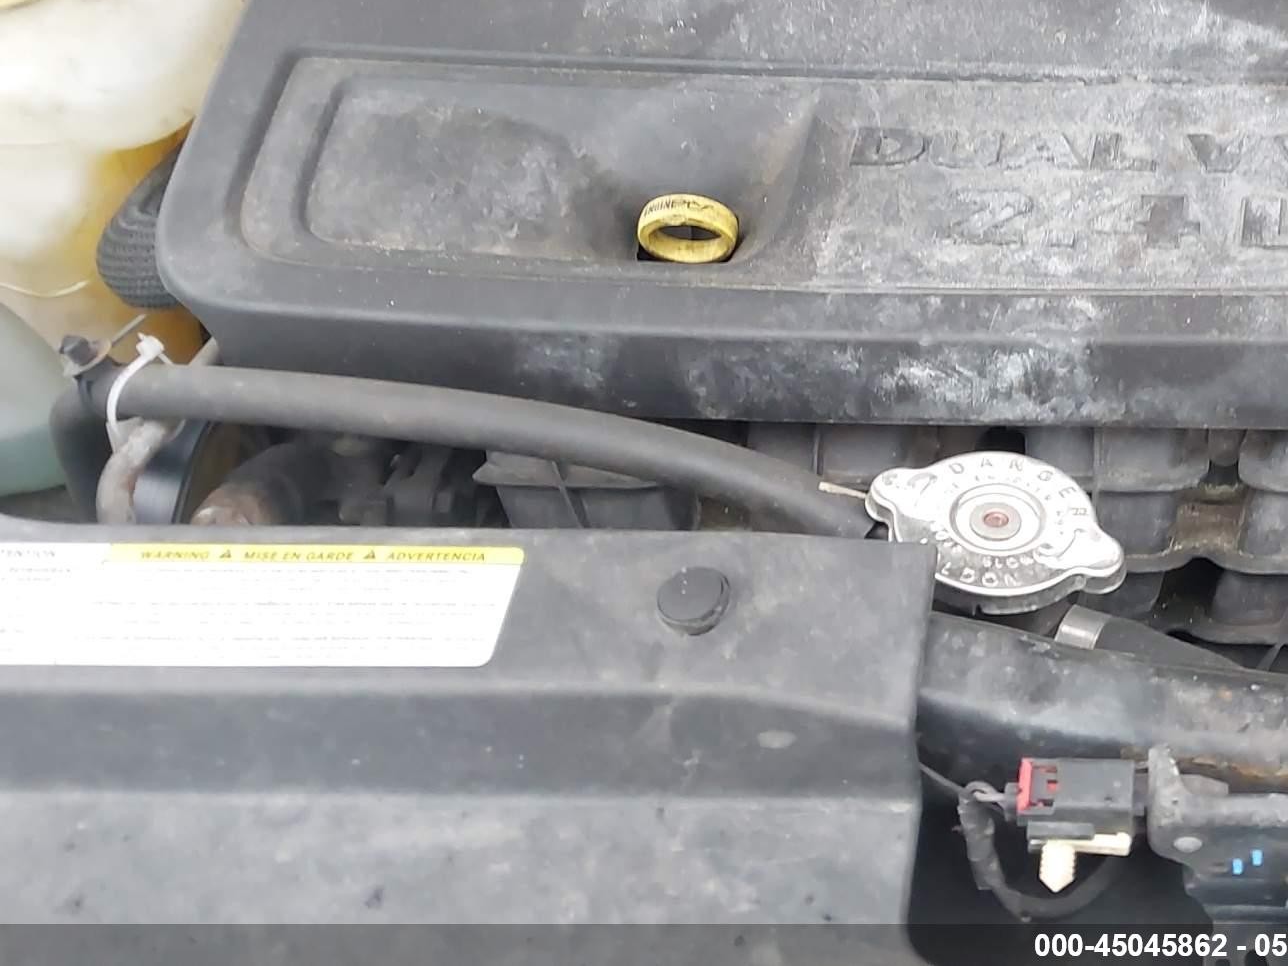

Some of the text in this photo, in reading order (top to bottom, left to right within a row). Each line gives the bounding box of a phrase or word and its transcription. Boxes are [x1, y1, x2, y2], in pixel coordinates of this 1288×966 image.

[849, 127, 1157, 172] DUAL
[949, 457, 1089, 516] DANGER
[141, 550, 487, 562] WARNING MISE EN GARDE ADVERTENCIA
